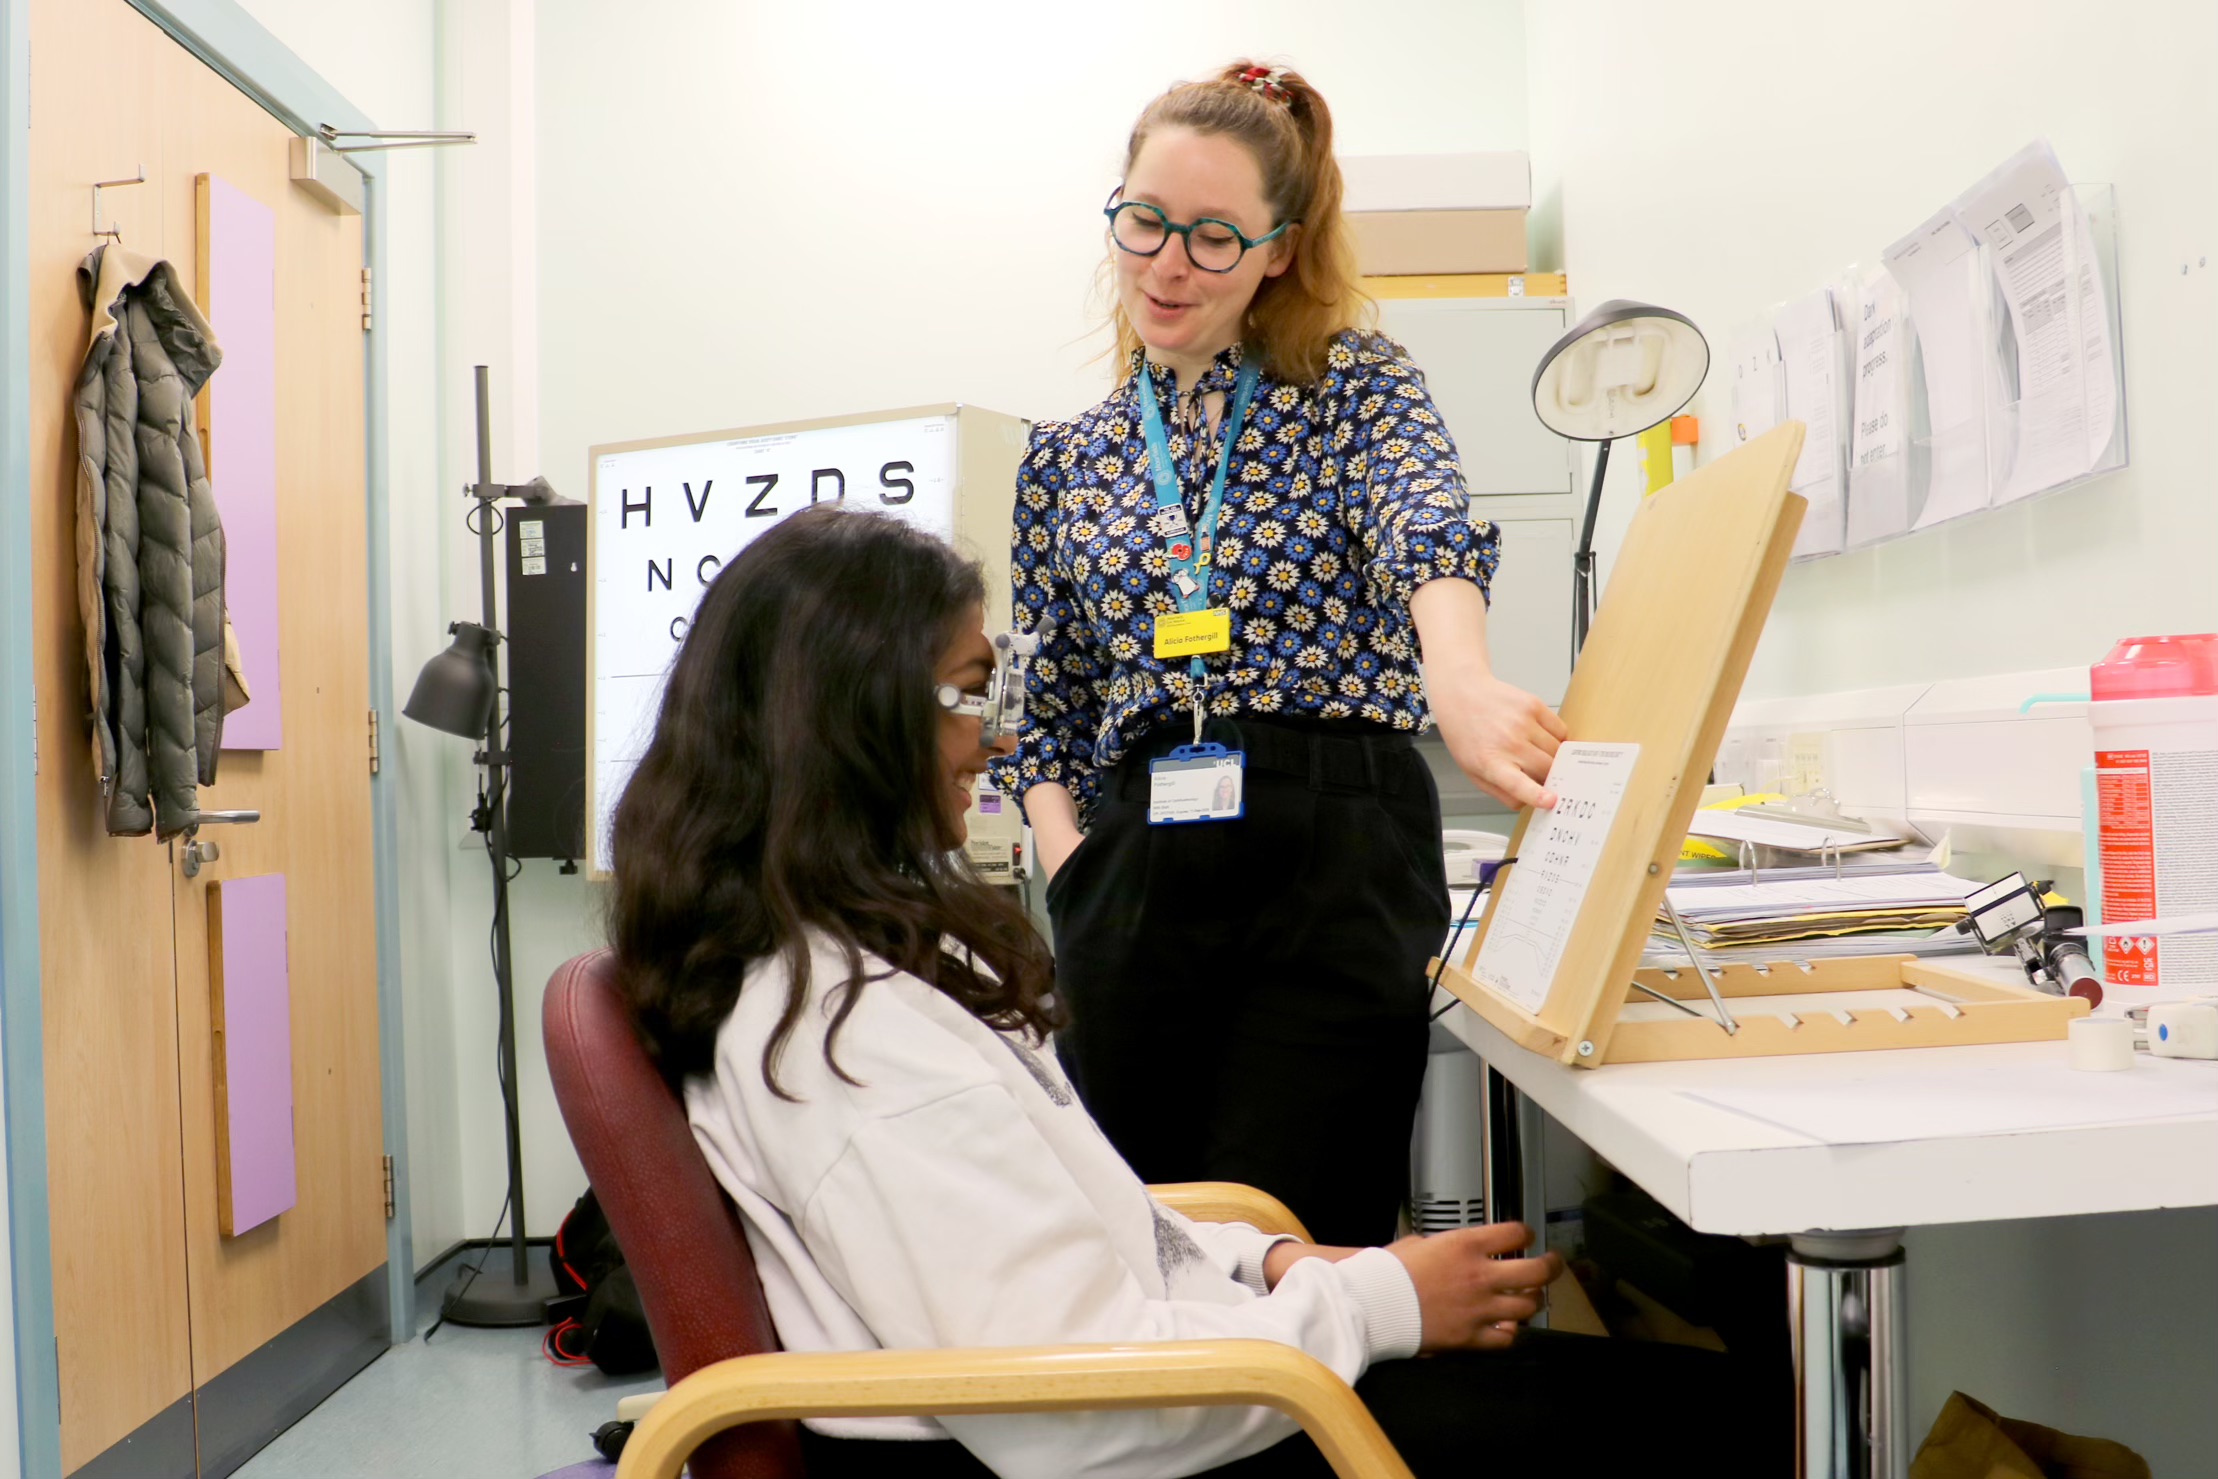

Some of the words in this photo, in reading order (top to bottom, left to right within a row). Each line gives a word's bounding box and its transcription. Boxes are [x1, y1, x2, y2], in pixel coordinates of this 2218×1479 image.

[1861, 418, 1878, 440] Please
[621, 486, 652, 530] H
[682, 480, 714, 523] V
[745, 473, 779, 519] Z
[811, 468, 846, 505] D
[879, 460, 915, 506] S
[647, 557, 673, 592] N
[1164, 637, 1183, 646] Alicia
[1184, 632, 1218, 642] Fothergill
